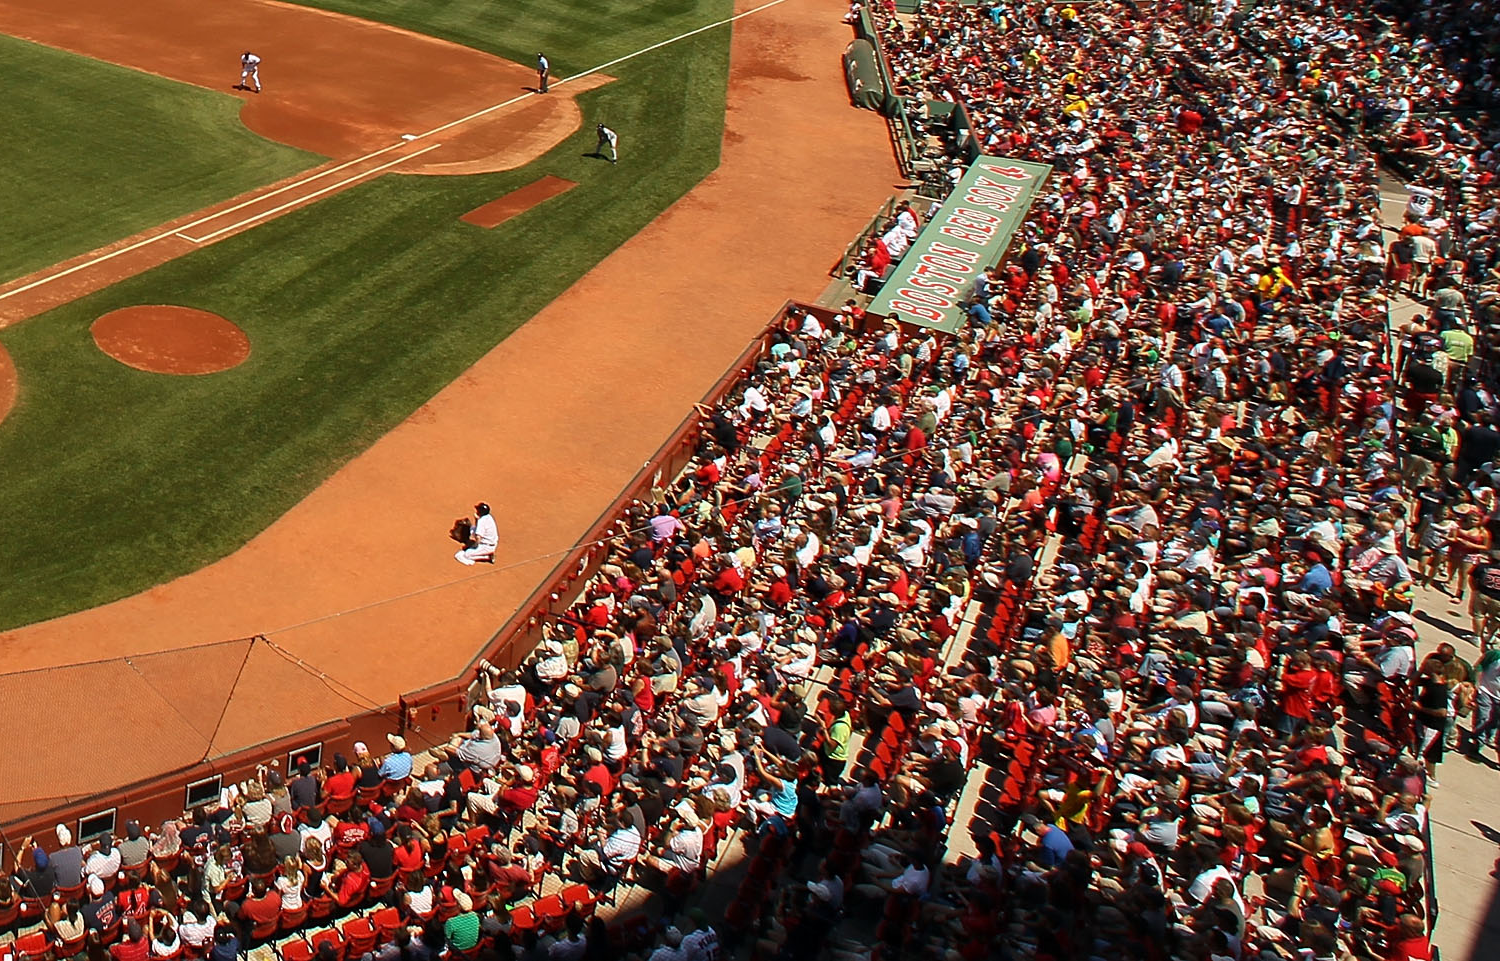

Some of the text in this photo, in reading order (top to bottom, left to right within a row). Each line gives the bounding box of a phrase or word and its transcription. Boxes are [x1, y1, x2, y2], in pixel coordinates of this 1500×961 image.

[963, 175, 1023, 213] SOX
[939, 207, 1002, 246] RED
[888, 241, 981, 323] BOSTON
